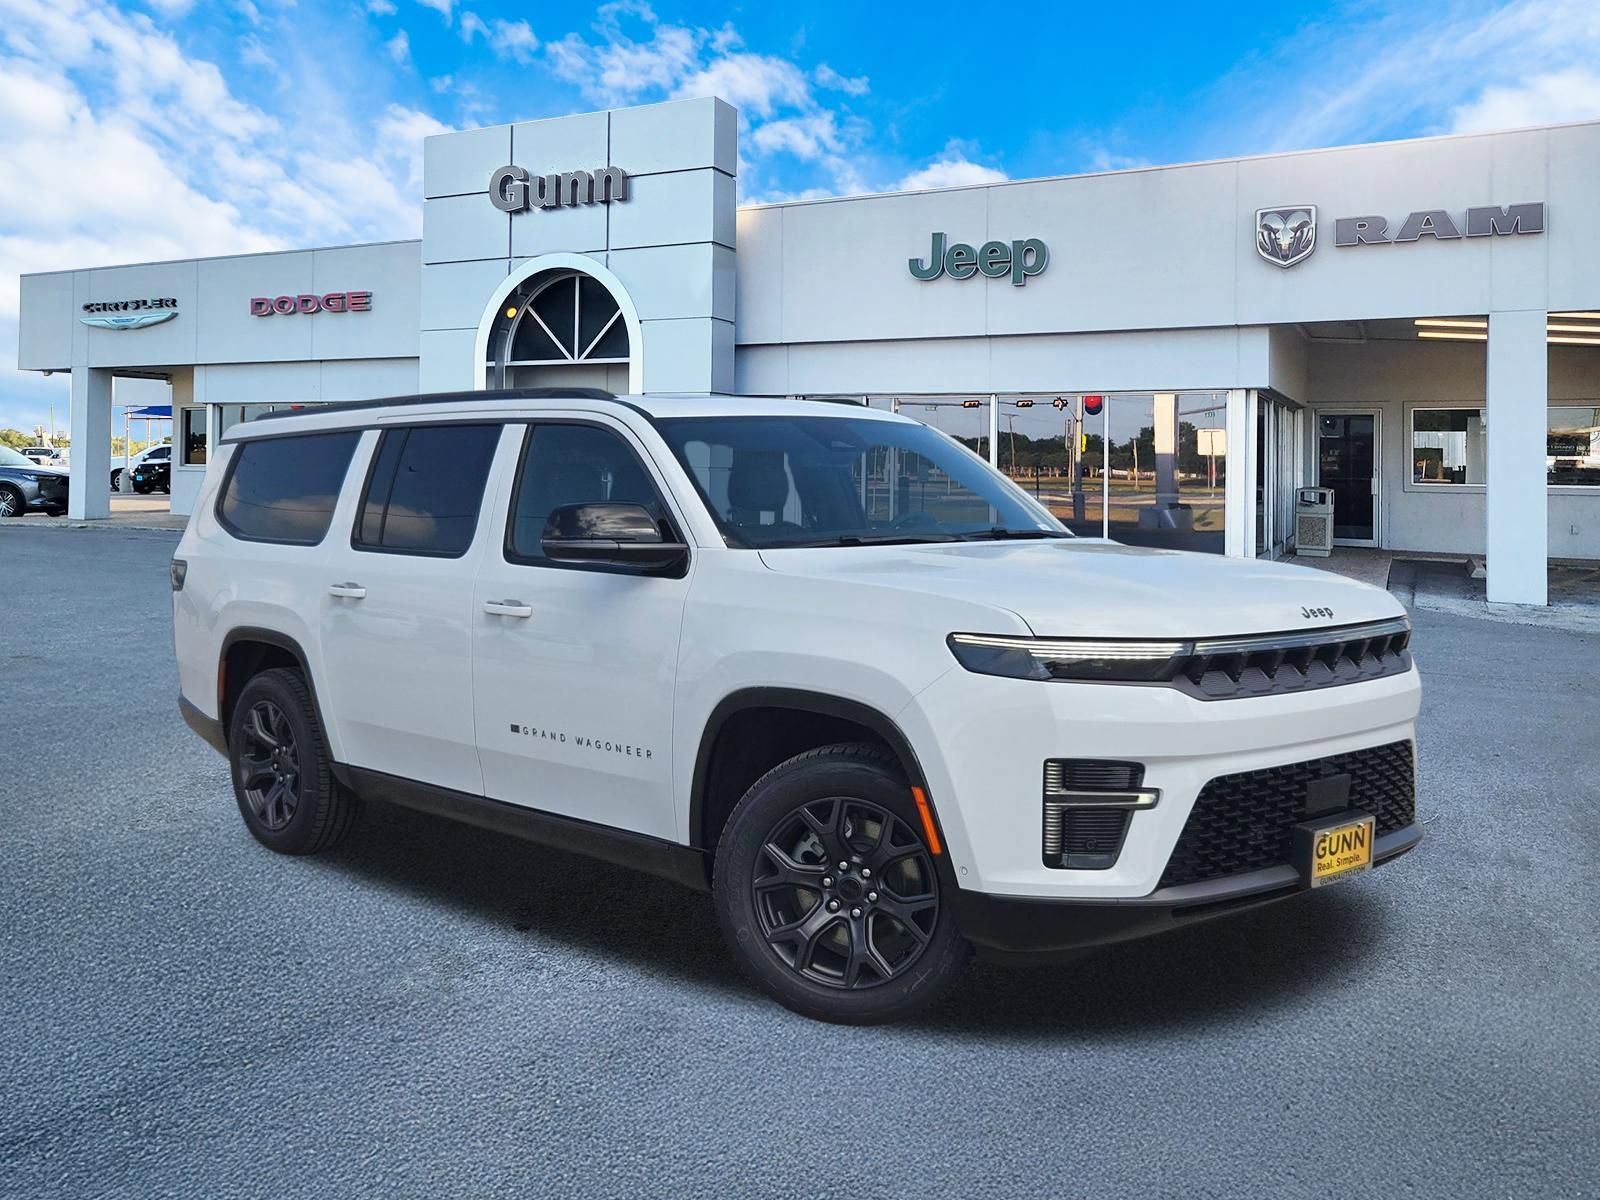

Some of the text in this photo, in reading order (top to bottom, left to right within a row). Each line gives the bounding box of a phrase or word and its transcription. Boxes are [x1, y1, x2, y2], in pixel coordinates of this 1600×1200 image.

[489, 165, 627, 213] Gunn
[1335, 202, 1545, 247] RAM
[908, 231, 1049, 286] Jeep
[83, 298, 178, 313] CHRYSLER
[250, 291, 373, 317] DODGE
[1300, 606, 1334, 619] Jeep
[522, 726, 652, 759] GRAND WAGONEER
[1316, 828, 1365, 859] GUNN
[1317, 853, 1362, 872] Real. Simple.
